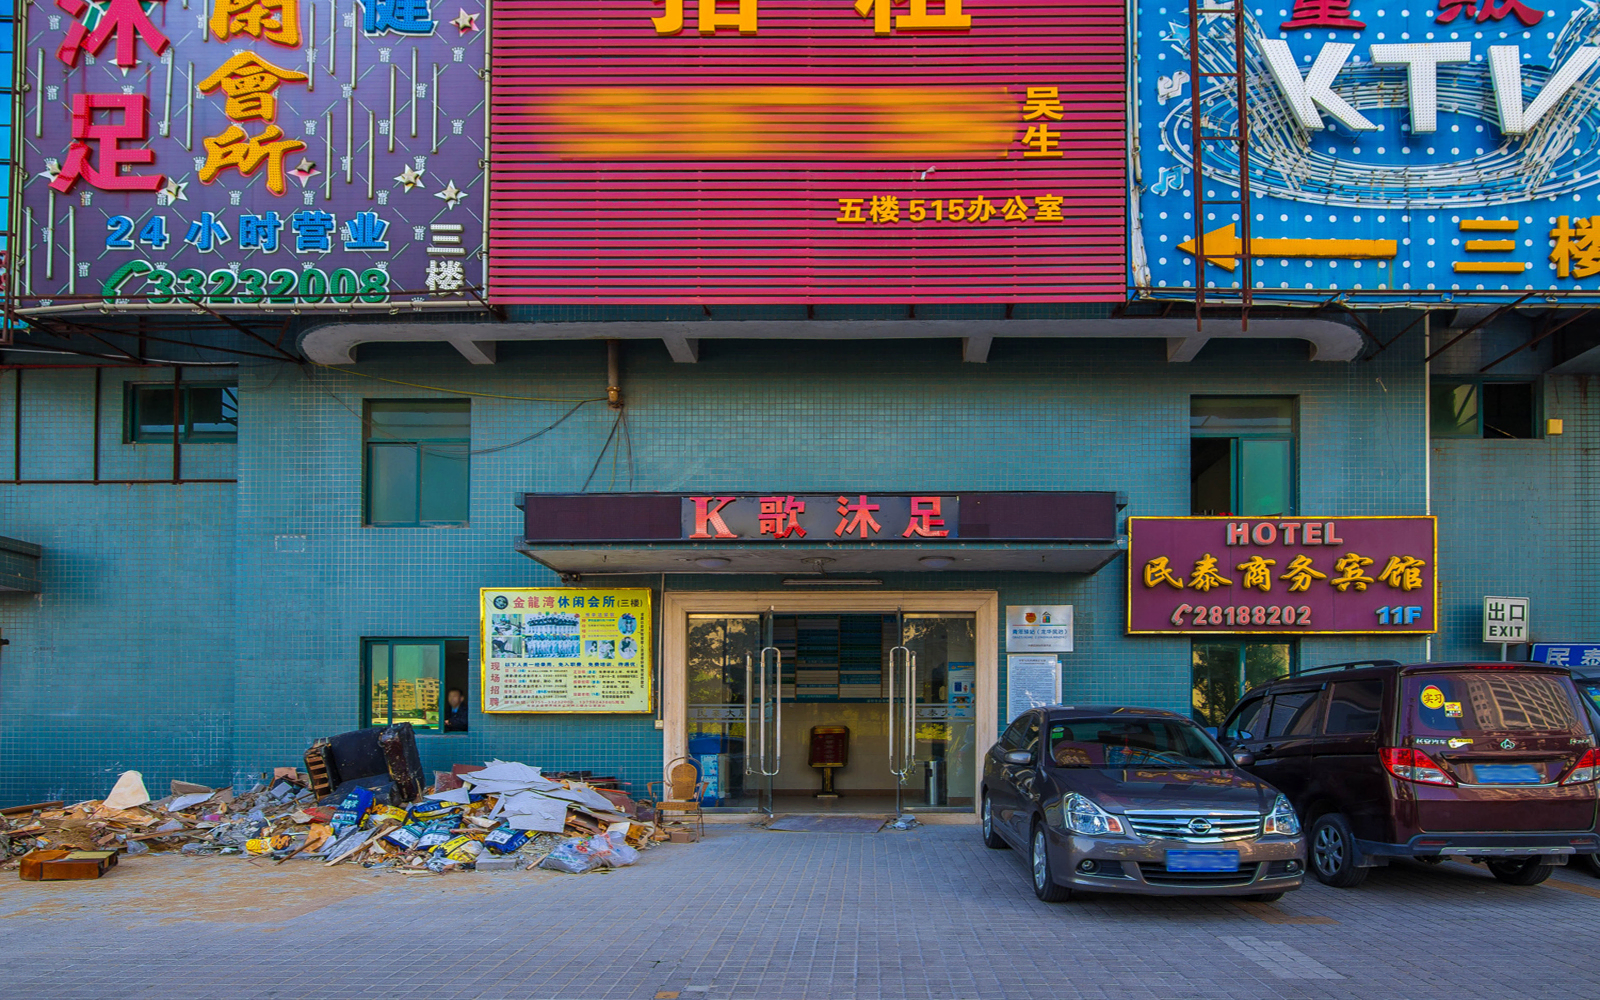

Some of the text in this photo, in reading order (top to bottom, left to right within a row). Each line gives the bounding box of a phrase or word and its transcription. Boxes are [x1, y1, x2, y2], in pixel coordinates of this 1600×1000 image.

[1257, 38, 1600, 136] KTV
[1021, 86, 1065, 160] 吴生
[425, 222, 468, 296] 三楼
[1453, 214, 1600, 280] 三楼
[146, 267, 391, 304] 33232008
[688, 495, 951, 540] K歌沐足
[1226, 522, 1344, 546] HOTEL
[1143, 552, 1428, 592] 民泰商务宾馆
[1191, 605, 1312, 626] 28188202
[1375, 605, 1423, 625] 11F
[1488, 602, 1525, 622] 出口
[1489, 625, 1523, 637] EXIT
[1545, 647, 1600, 666] 民泰
[1423, 692, 1443, 704] 实习
